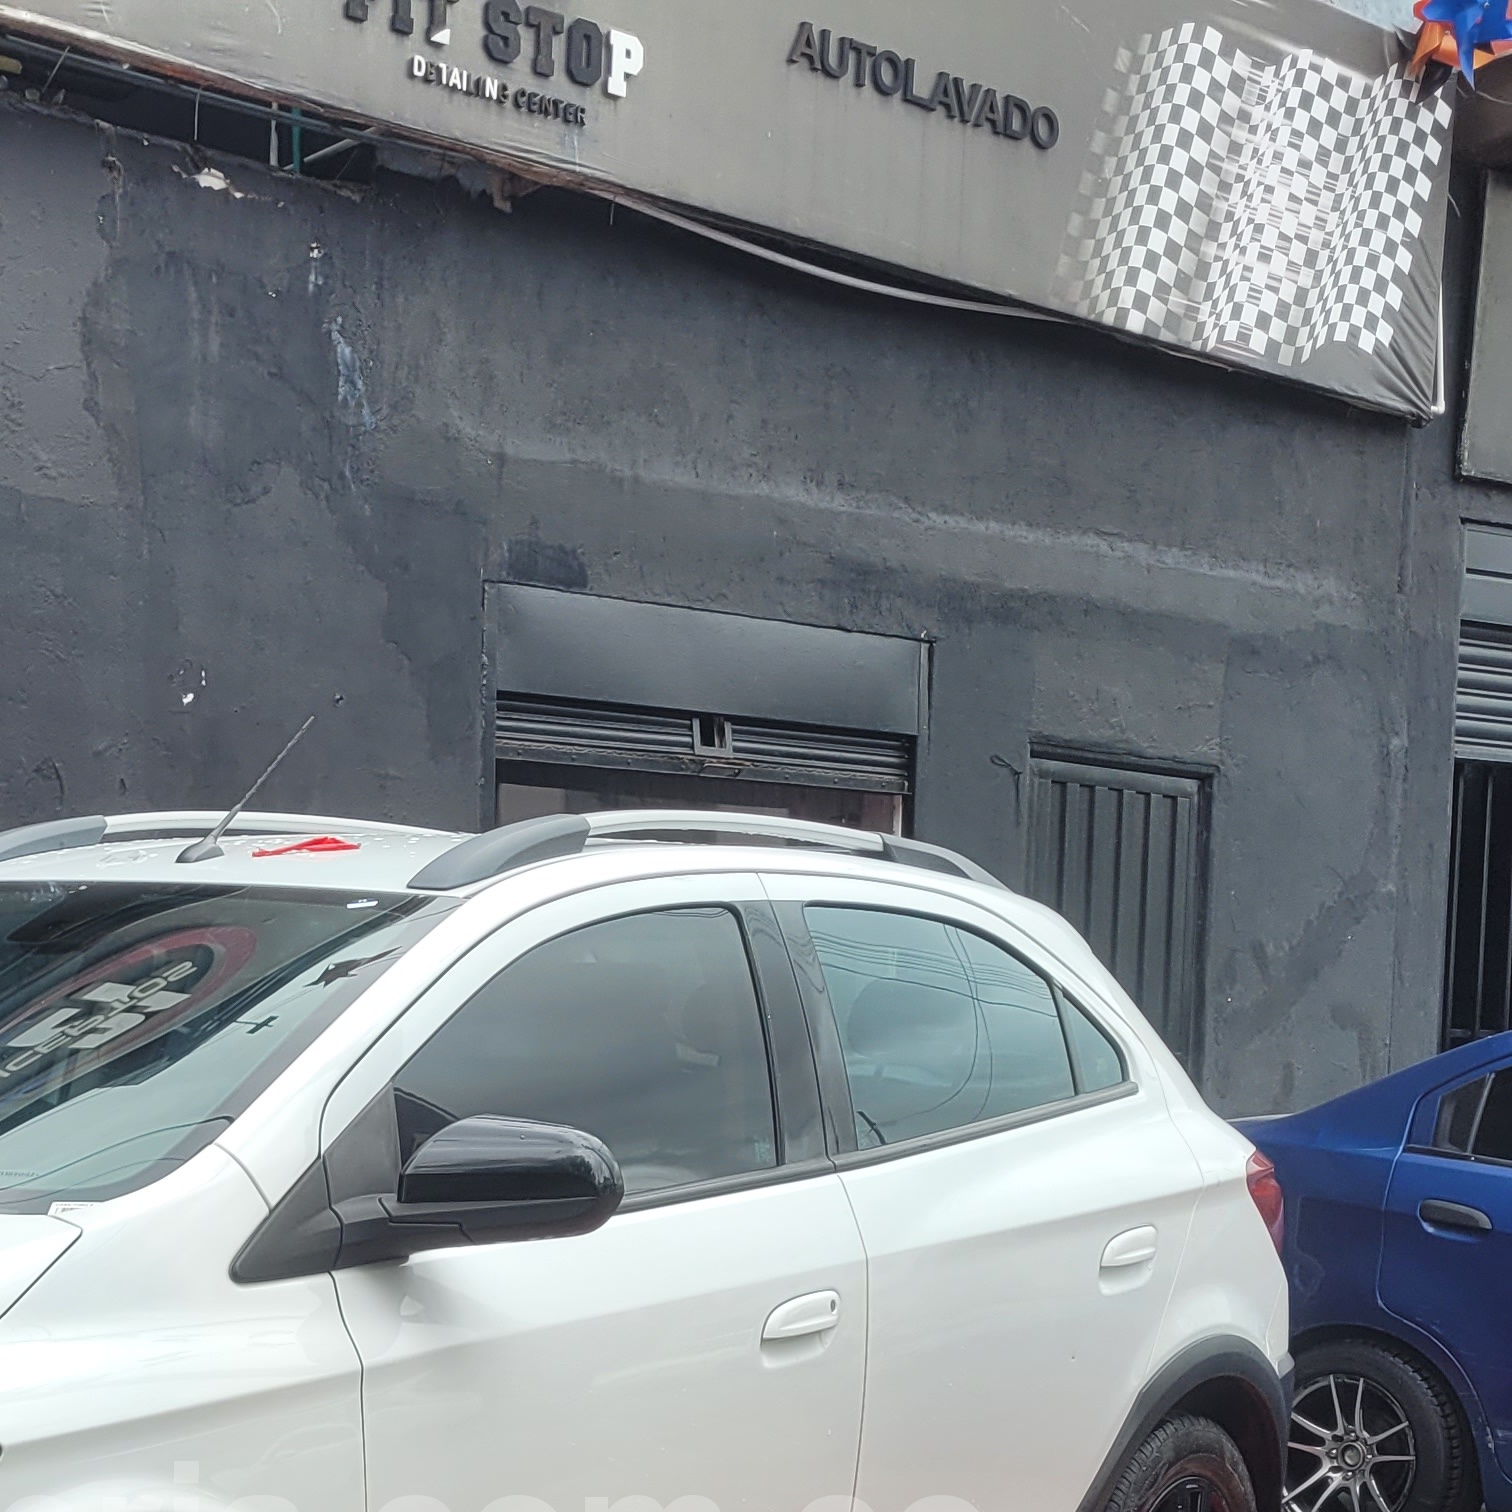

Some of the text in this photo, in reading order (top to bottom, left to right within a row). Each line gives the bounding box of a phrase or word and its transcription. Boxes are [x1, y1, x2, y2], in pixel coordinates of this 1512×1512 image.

[409, 55, 587, 127] DETAILING CENTER
[482, 0, 644, 98] STOP
[786, 20, 1059, 149] AUTOLAVADO
